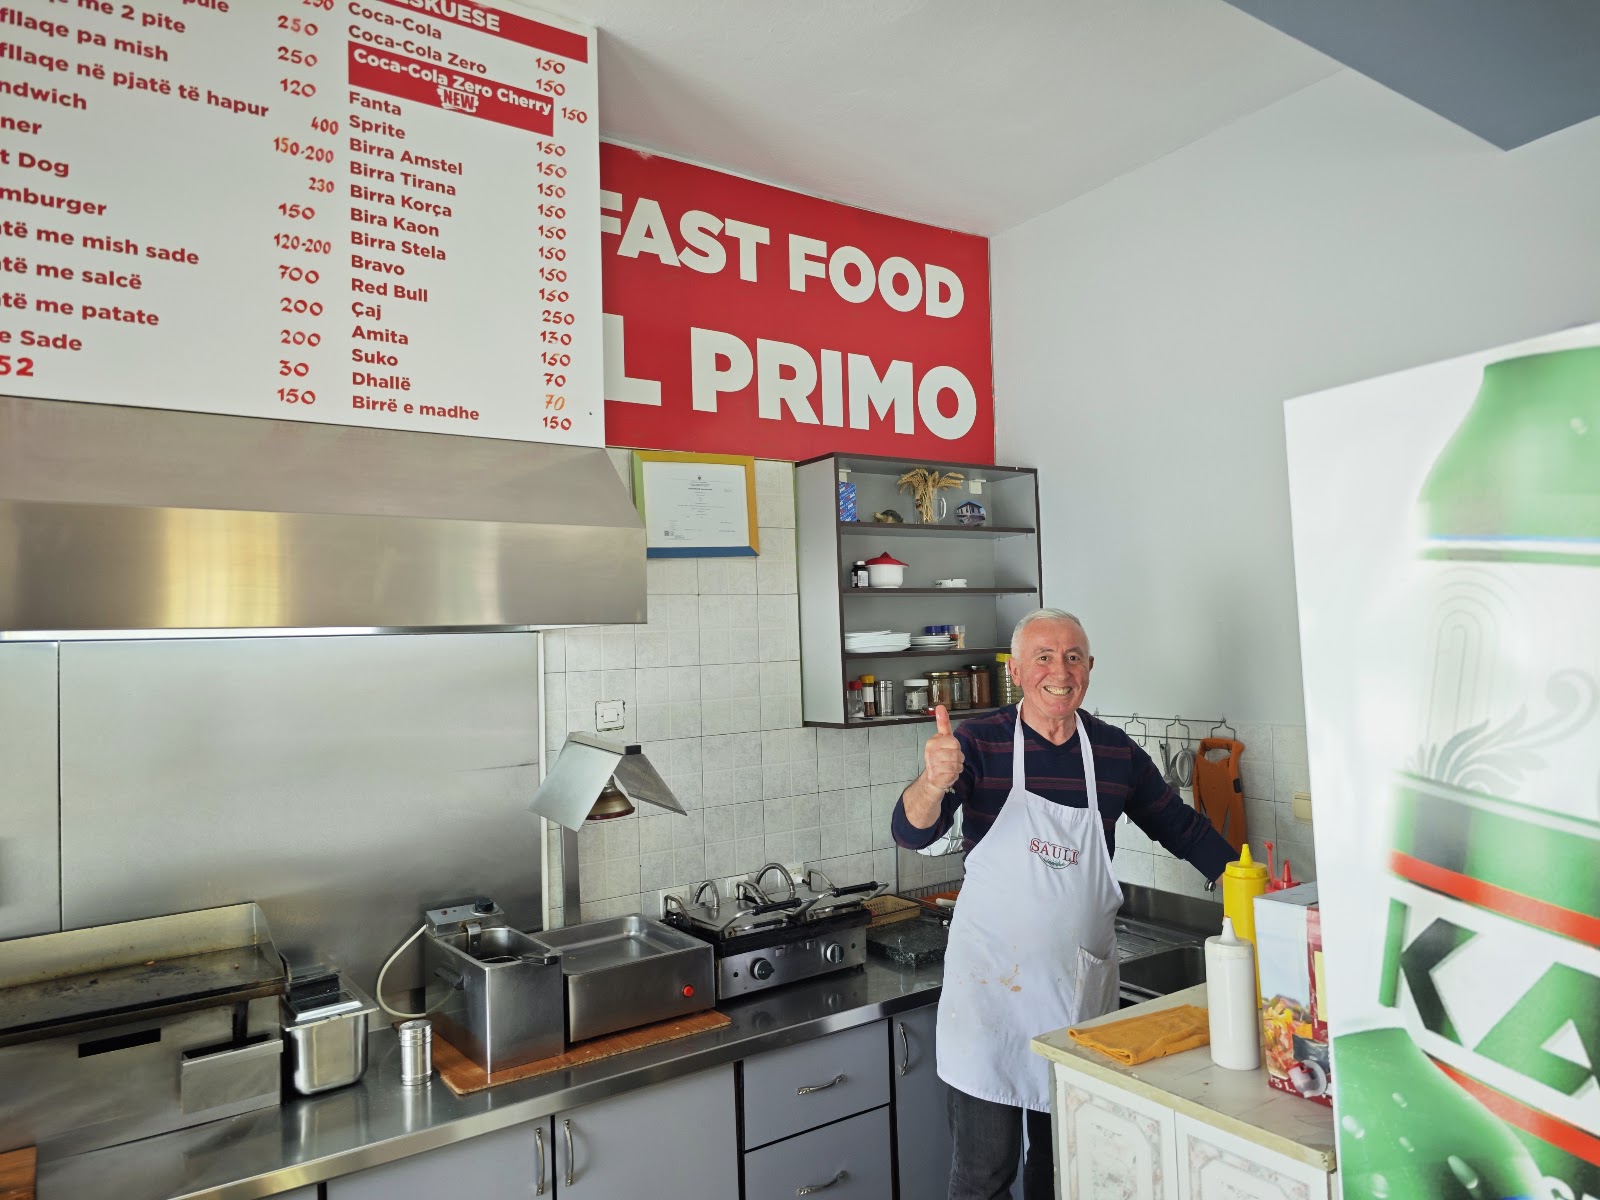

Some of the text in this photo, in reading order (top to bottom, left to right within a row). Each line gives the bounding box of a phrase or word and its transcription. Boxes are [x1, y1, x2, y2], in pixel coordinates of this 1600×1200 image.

[122, 5, 134, 19] 2
[142, 12, 185, 32] pite
[278, 15, 318, 36] 250
[348, 2, 441, 38] Coca-Cola
[394, 0, 500, 32] KUESE
[77, 30, 106, 46] pa
[114, 39, 168, 60] mish
[349, 25, 486, 74] Coca-Cola Zero
[278, 46, 318, 67] 250
[536, 58, 565, 74] 150
[76, 64, 105, 79] në
[113, 72, 170, 94] pjatë
[179, 85, 199, 100] të
[207, 90, 267, 116] hapur
[281, 78, 317, 98] 120
[353, 48, 553, 116] Coca-Cola Zero Cherry
[536, 79, 565, 96] 150
[349, 91, 401, 116] Fanta
[443, 89, 475, 110] NEW
[562, 107, 588, 124] 150
[311, 118, 339, 135] 400
[349, 114, 405, 139] Sprite
[350, 137, 462, 174] Birra Amstel
[537, 141, 566, 156] 150
[18, 152, 69, 178] Dog
[537, 162, 567, 178] 150
[350, 161, 456, 195] Birra Tirana
[350, 184, 452, 217] Birra Korça
[538, 183, 566, 199] 150
[278, 203, 316, 220] 150
[350, 207, 439, 236] Bira Kaon
[538, 204, 566, 219] 150
[0, 220, 199, 264] të me mish sade
[538, 226, 566, 240] 150
[274, 234, 332, 254] 120-200
[351, 231, 446, 260] Birra Stela
[600, 189, 965, 319] FAST FOOD
[351, 254, 405, 275] Bravo
[539, 247, 566, 262] 150
[0, 255, 141, 289] të me salcë
[279, 264, 320, 284] 700
[539, 268, 567, 283] 150
[351, 278, 428, 302] Red Bull
[539, 288, 569, 303] 150
[0, 291, 158, 326] të me patate
[281, 297, 324, 316] 200
[352, 301, 381, 320] Çaj
[543, 310, 575, 325] 250
[20, 330, 81, 350] Sade
[281, 329, 321, 347] 200
[352, 325, 408, 344] Amita
[352, 348, 398, 366] Suko
[541, 352, 571, 367] 150
[279, 360, 310, 378] 30
[352, 372, 411, 390] Dhallë
[544, 372, 566, 387] 70
[690, 326, 977, 440] PRIMO
[277, 388, 316, 405] 150
[546, 394, 565, 410] 70
[352, 395, 479, 420] Birrë e madhe
[543, 416, 572, 431] 150
[1031, 838, 1078, 864] SAULI
